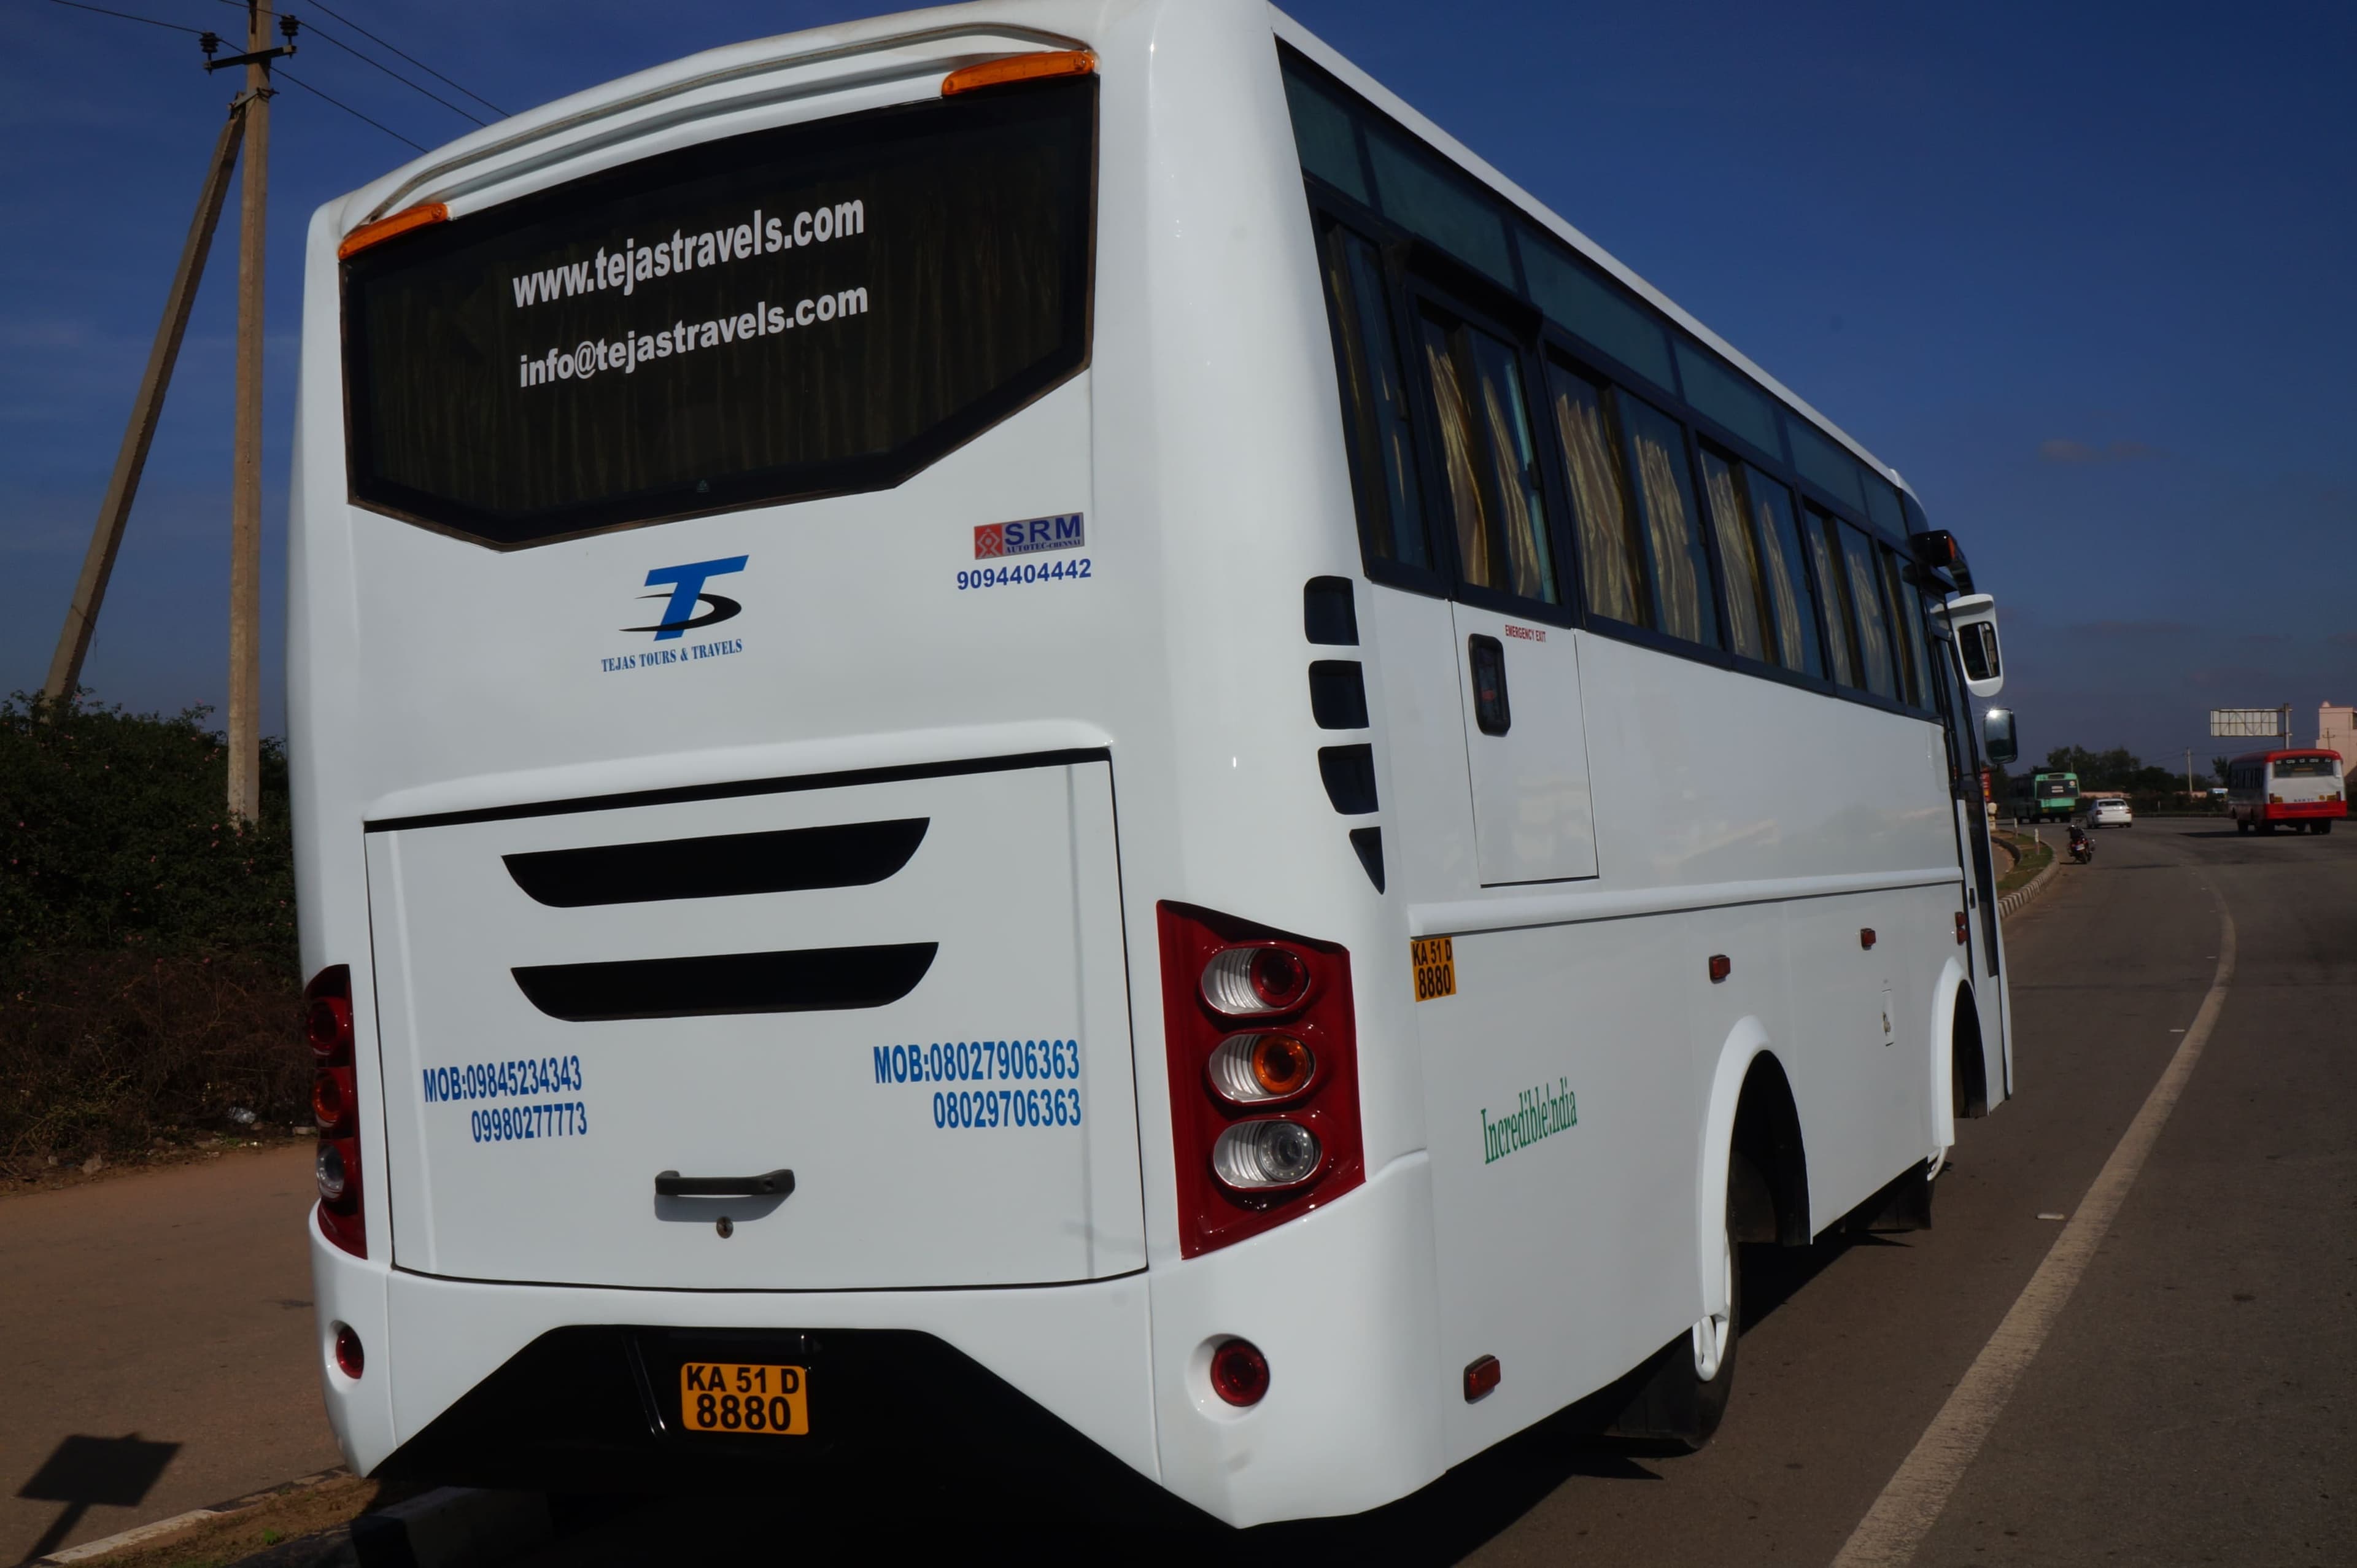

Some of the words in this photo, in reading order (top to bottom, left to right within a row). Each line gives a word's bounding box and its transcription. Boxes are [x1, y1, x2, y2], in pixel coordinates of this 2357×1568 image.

[513, 199, 864, 307] www.tejastravels.com
[521, 287, 868, 387] info@tejastravels.com
[1005, 515, 1080, 546] SRM
[957, 558, 1091, 590] 9094404442
[1505, 625, 1535, 641] EMERGENCY
[1536, 630, 1546, 643] EXIT
[601, 655, 636, 672] TEJAS
[639, 649, 676, 665] TOURS
[680, 647, 688, 662] &
[691, 638, 743, 659] TRAVELS
[1412, 943, 1428, 967] KA
[1430, 940, 1442, 964] 51
[1445, 939, 1452, 961] D
[1418, 964, 1451, 998] 8880
[423, 1055, 582, 1102] MOB:09845234343
[873, 1040, 1080, 1083] MOB:08027906363
[471, 1102, 587, 1143] 09980277773
[933, 1088, 1082, 1129] 08029706363
[686, 1365, 727, 1392] KA
[737, 1367, 767, 1393] 51
[781, 1369, 800, 1394] D
[697, 1393, 791, 1431] 8880
